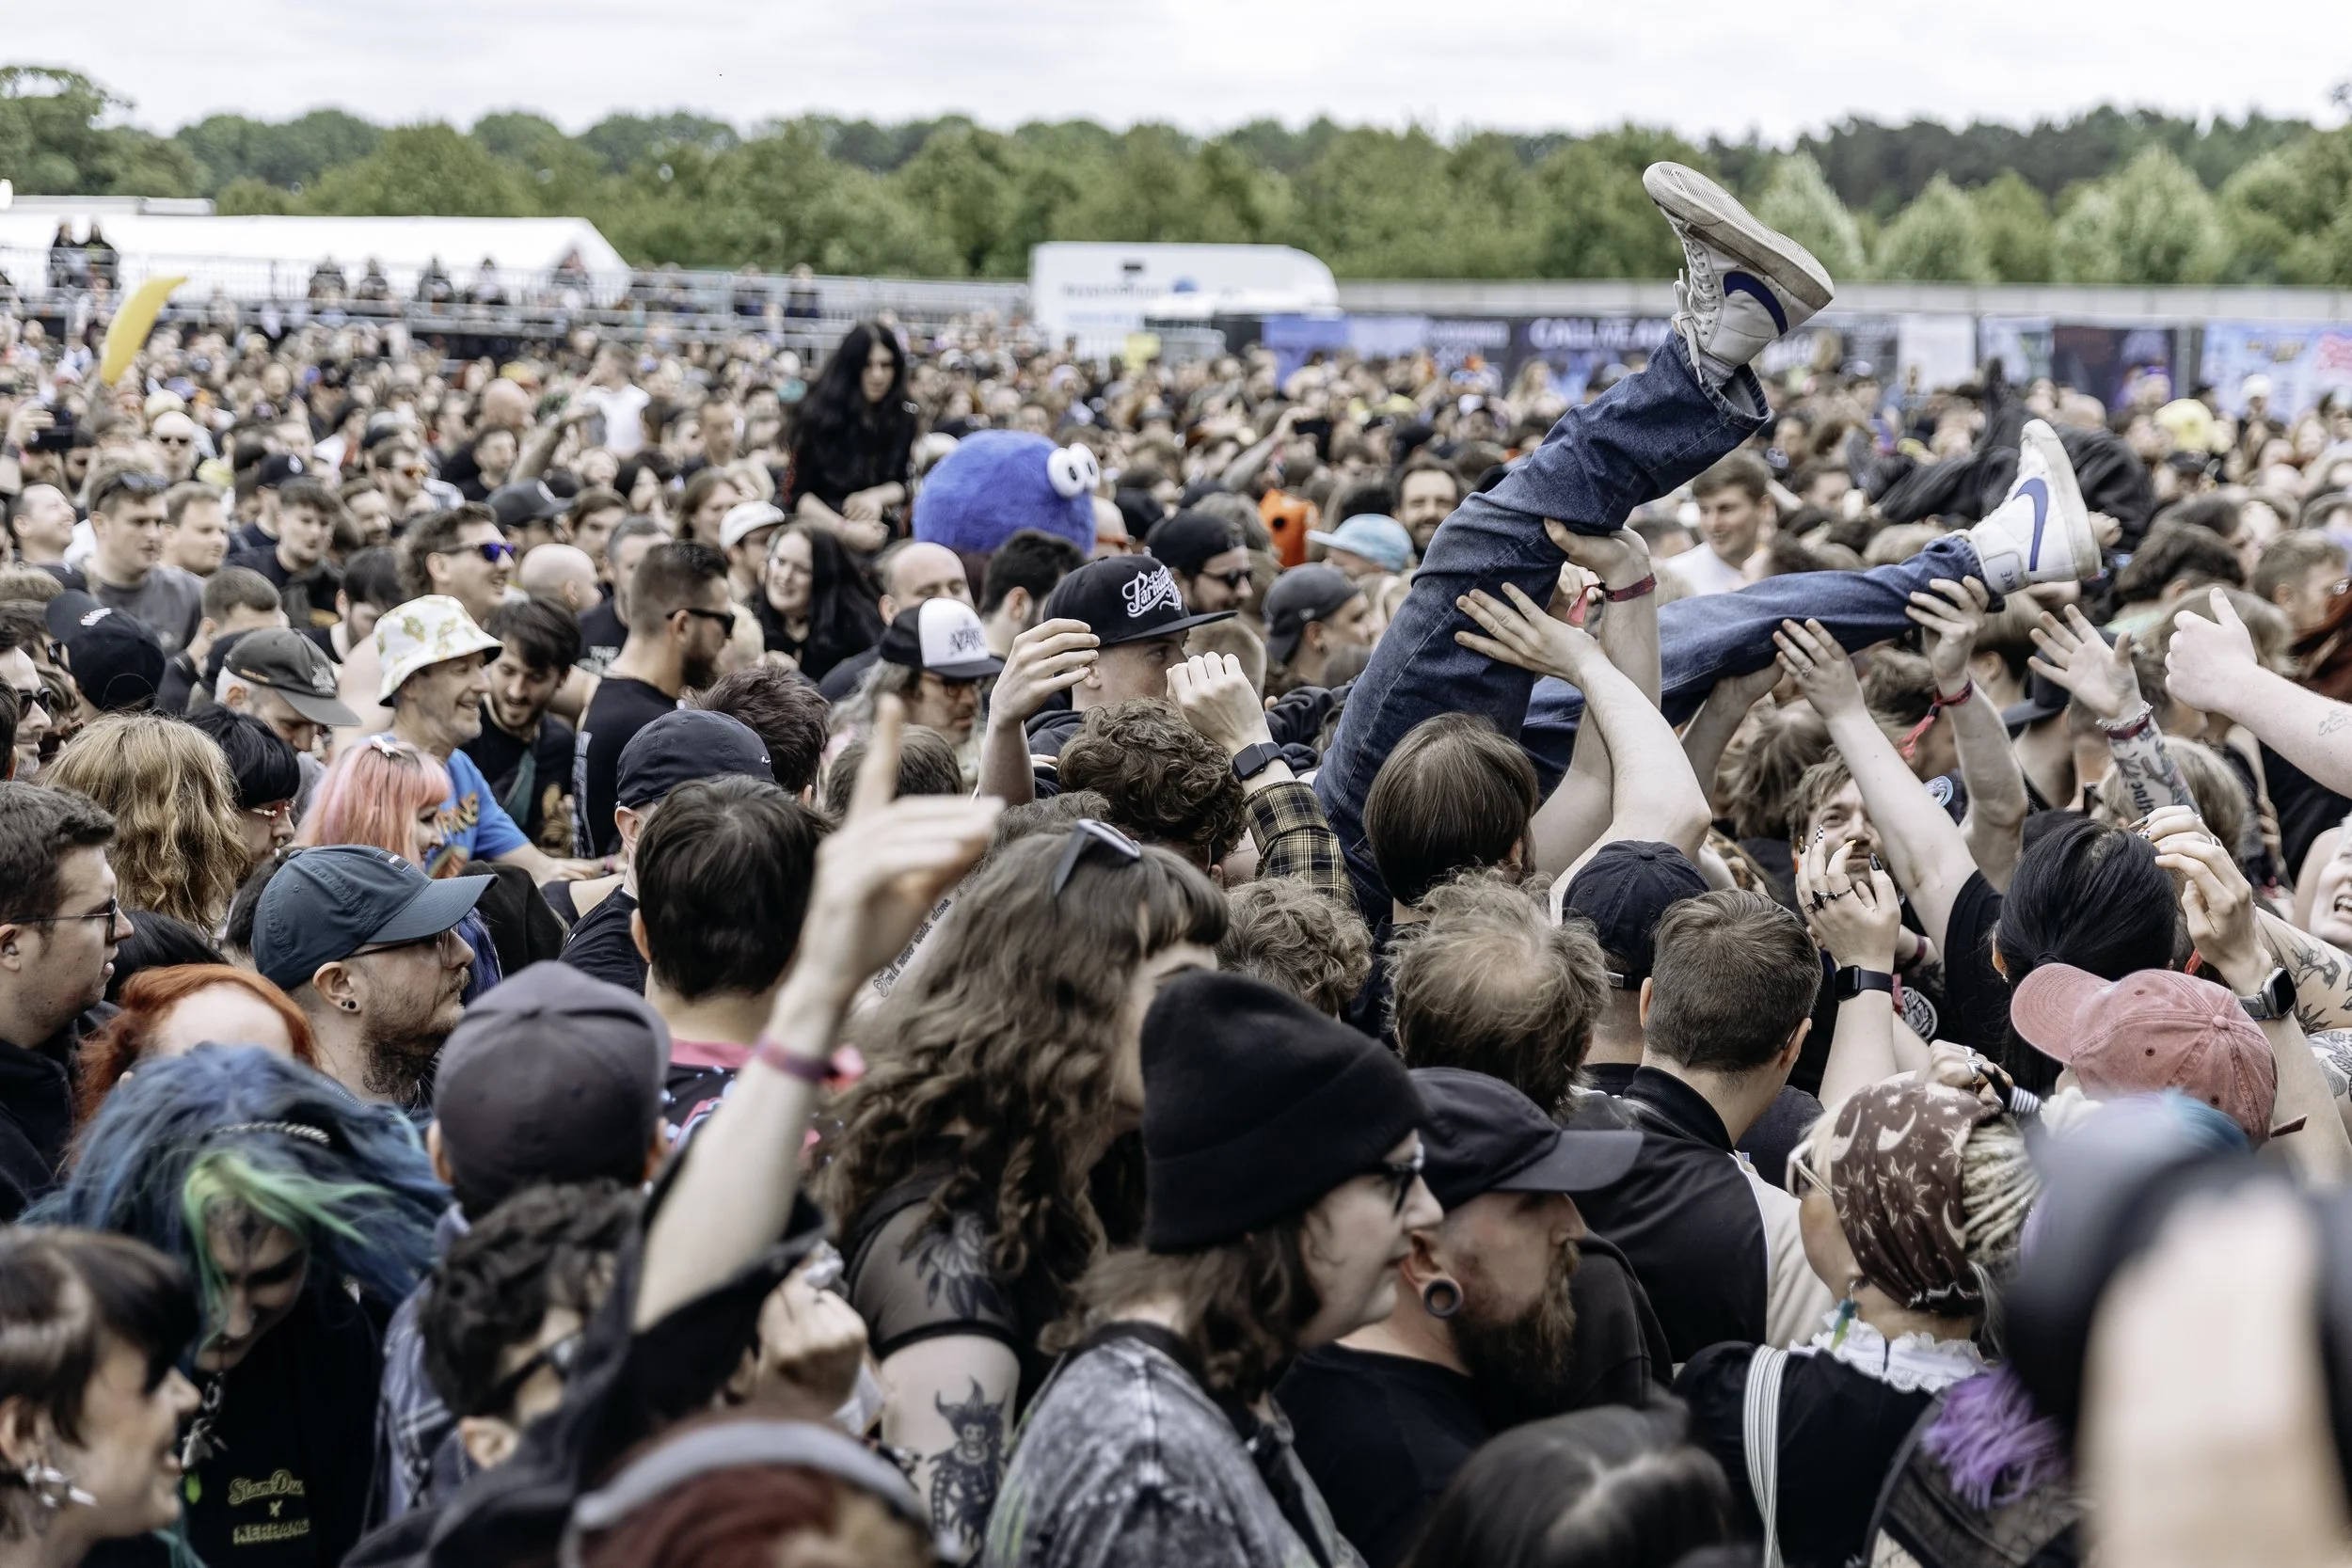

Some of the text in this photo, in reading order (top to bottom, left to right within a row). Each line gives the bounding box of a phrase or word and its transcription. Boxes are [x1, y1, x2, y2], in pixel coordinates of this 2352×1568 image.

[1529, 317, 1597, 351] CALL
[898, 943, 915, 968] never
[914, 920, 932, 944] walk
[931, 898, 951, 922] alone
